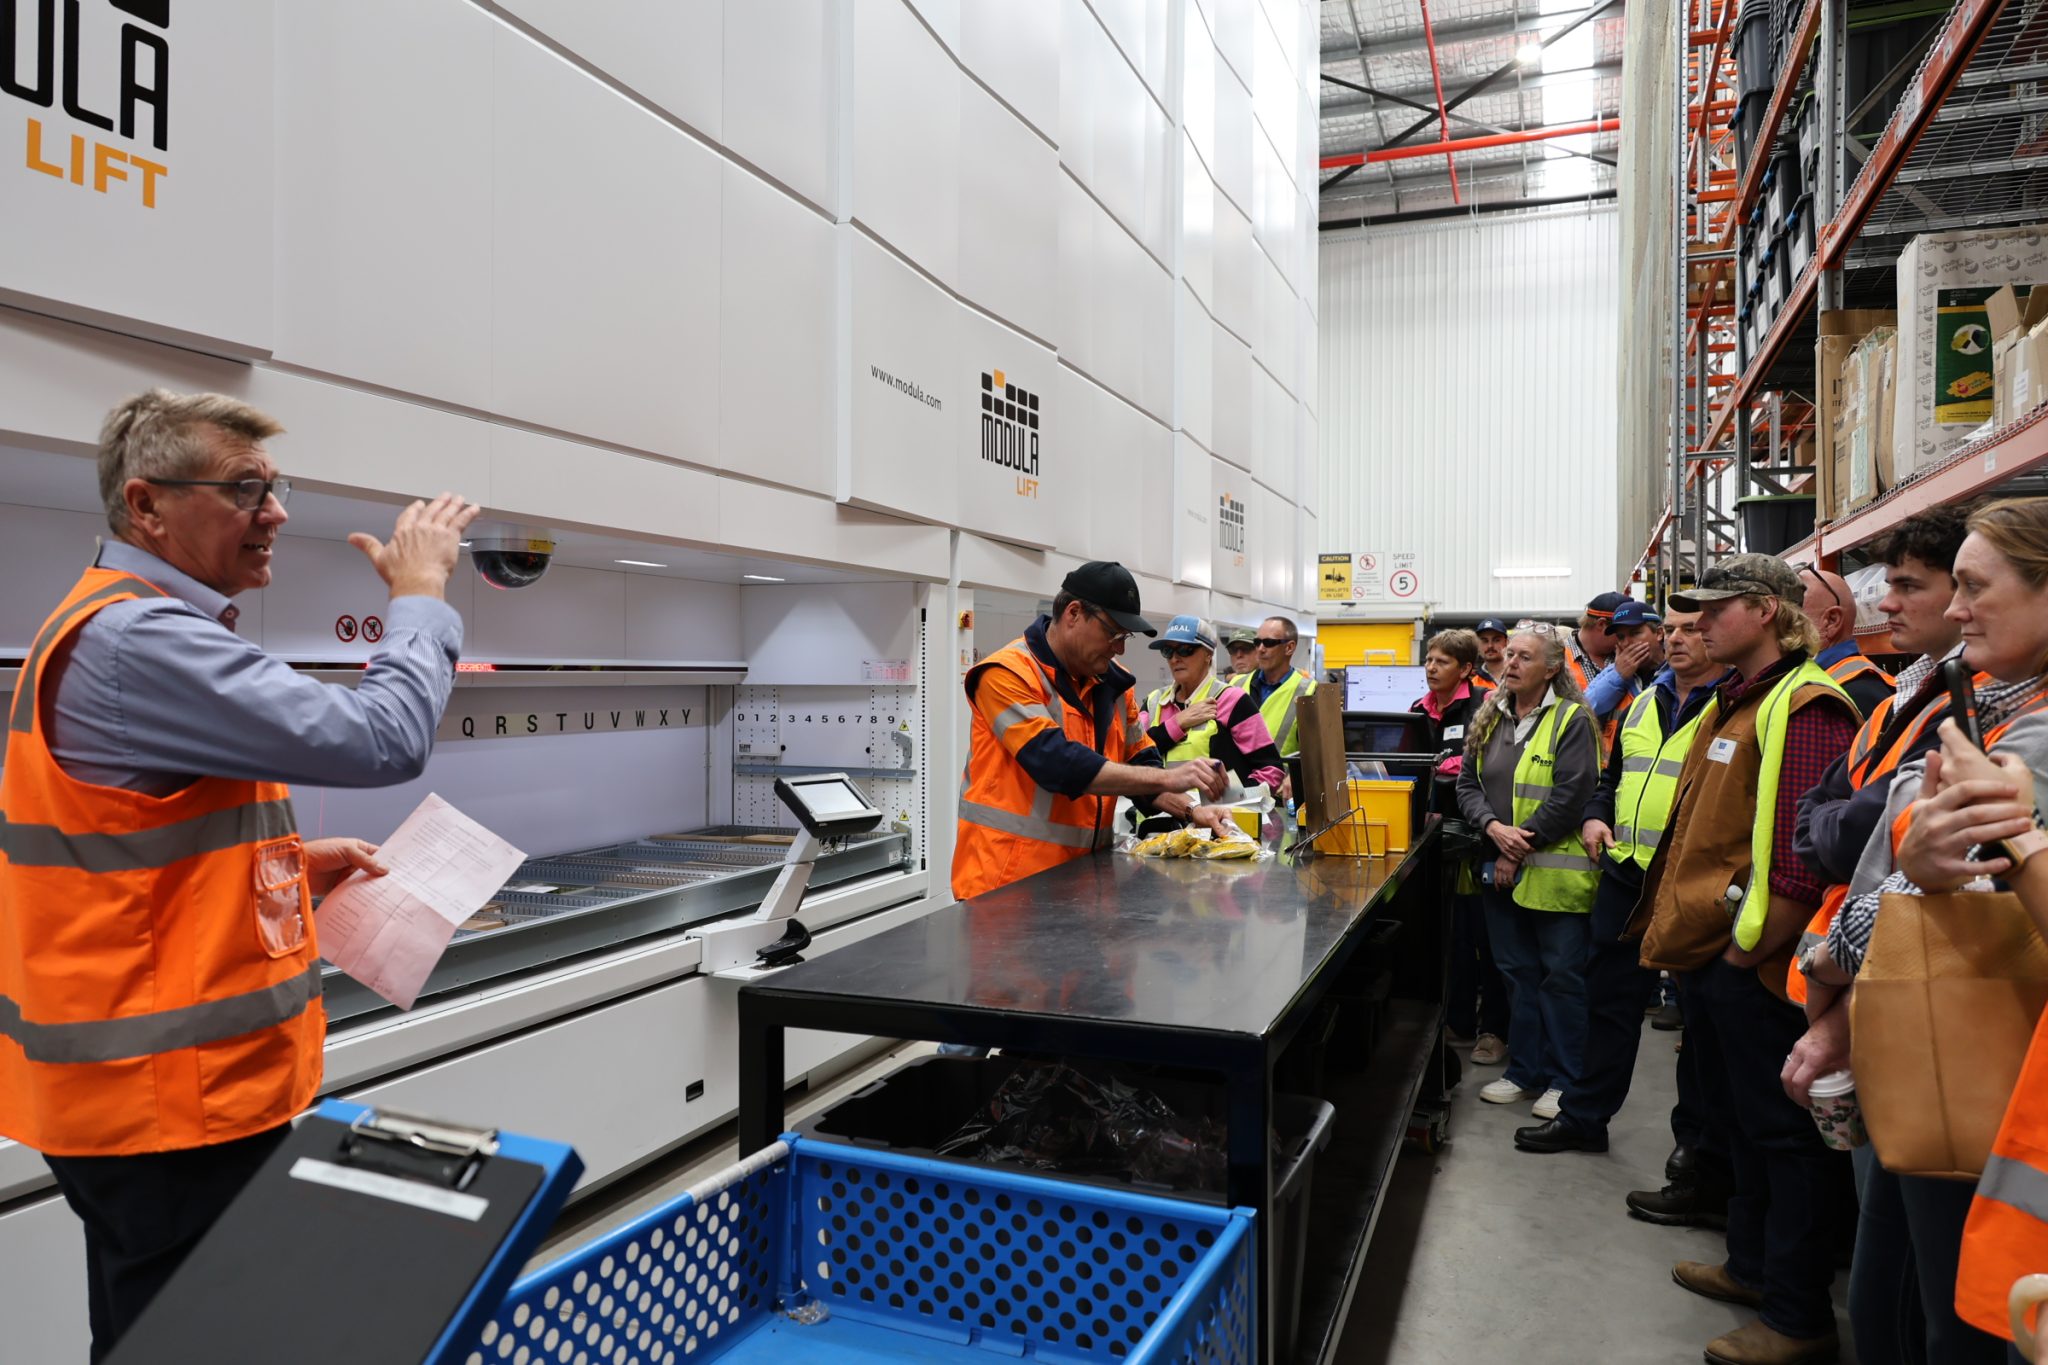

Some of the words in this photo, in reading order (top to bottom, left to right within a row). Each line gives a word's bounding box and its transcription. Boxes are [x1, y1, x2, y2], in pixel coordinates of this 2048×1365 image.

[26, 117, 168, 208] LIFT
[871, 364, 942, 411] www.modula.com
[982, 412, 1039, 476] MODULA
[1016, 475, 1038, 499] LIFT
[1220, 520, 1244, 553] MODULA
[1399, 577, 1408, 590] 5
[462, 716, 474, 738] Q
[496, 716, 506, 734] R
[527, 714, 538, 732] S
[556, 713, 567, 731] T
[584, 712, 594, 730] U
[610, 711, 620, 728] V
[636, 710, 644, 727] W
[660, 710, 668, 726] X
[682, 708, 690, 724] Y
[738, 714, 745, 722] 0
[754, 714, 760, 722] 1
[770, 714, 777, 722] 2
[788, 715, 795, 723] 3
[804, 715, 812, 723] 4
[821, 715, 828, 723] 5
[838, 715, 846, 723] 6
[855, 715, 862, 723] 7
[870, 716, 878, 724] 8
[887, 716, 895, 724] 9
